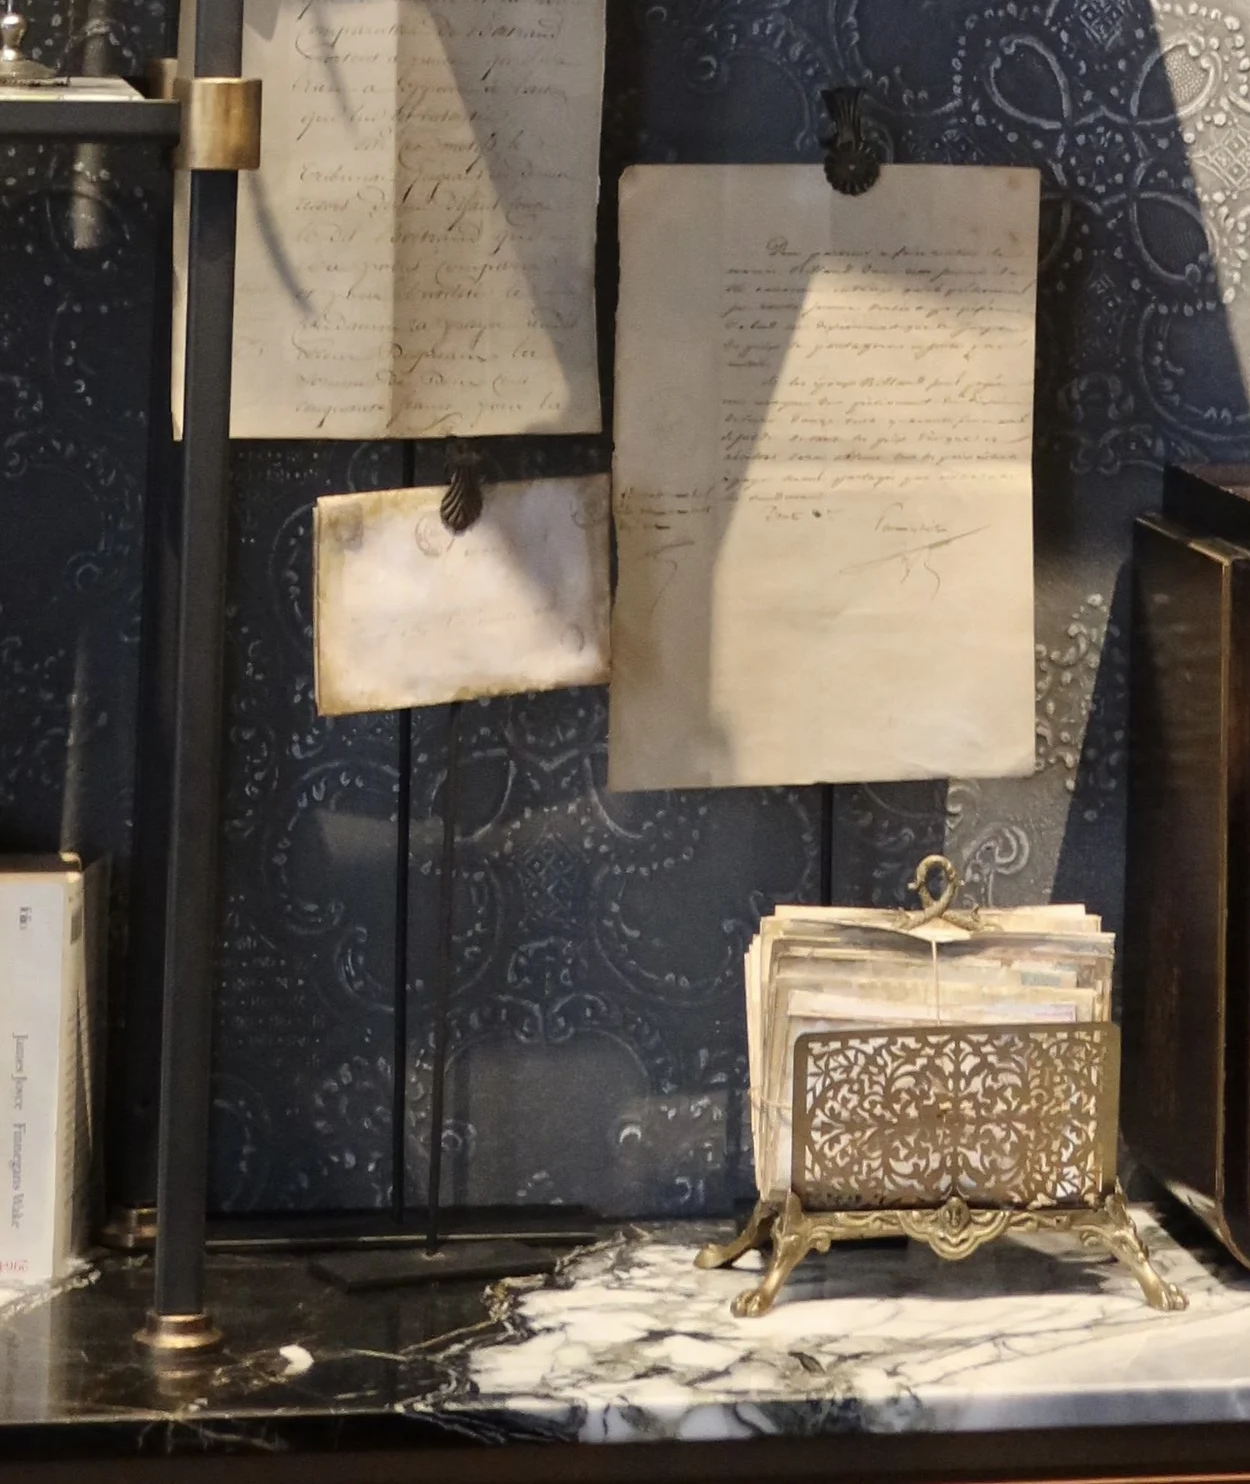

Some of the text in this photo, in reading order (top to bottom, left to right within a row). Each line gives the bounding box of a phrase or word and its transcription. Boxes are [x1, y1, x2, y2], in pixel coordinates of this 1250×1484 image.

[9, 1031, 28, 1229] James Joyce Finnegans Wake
